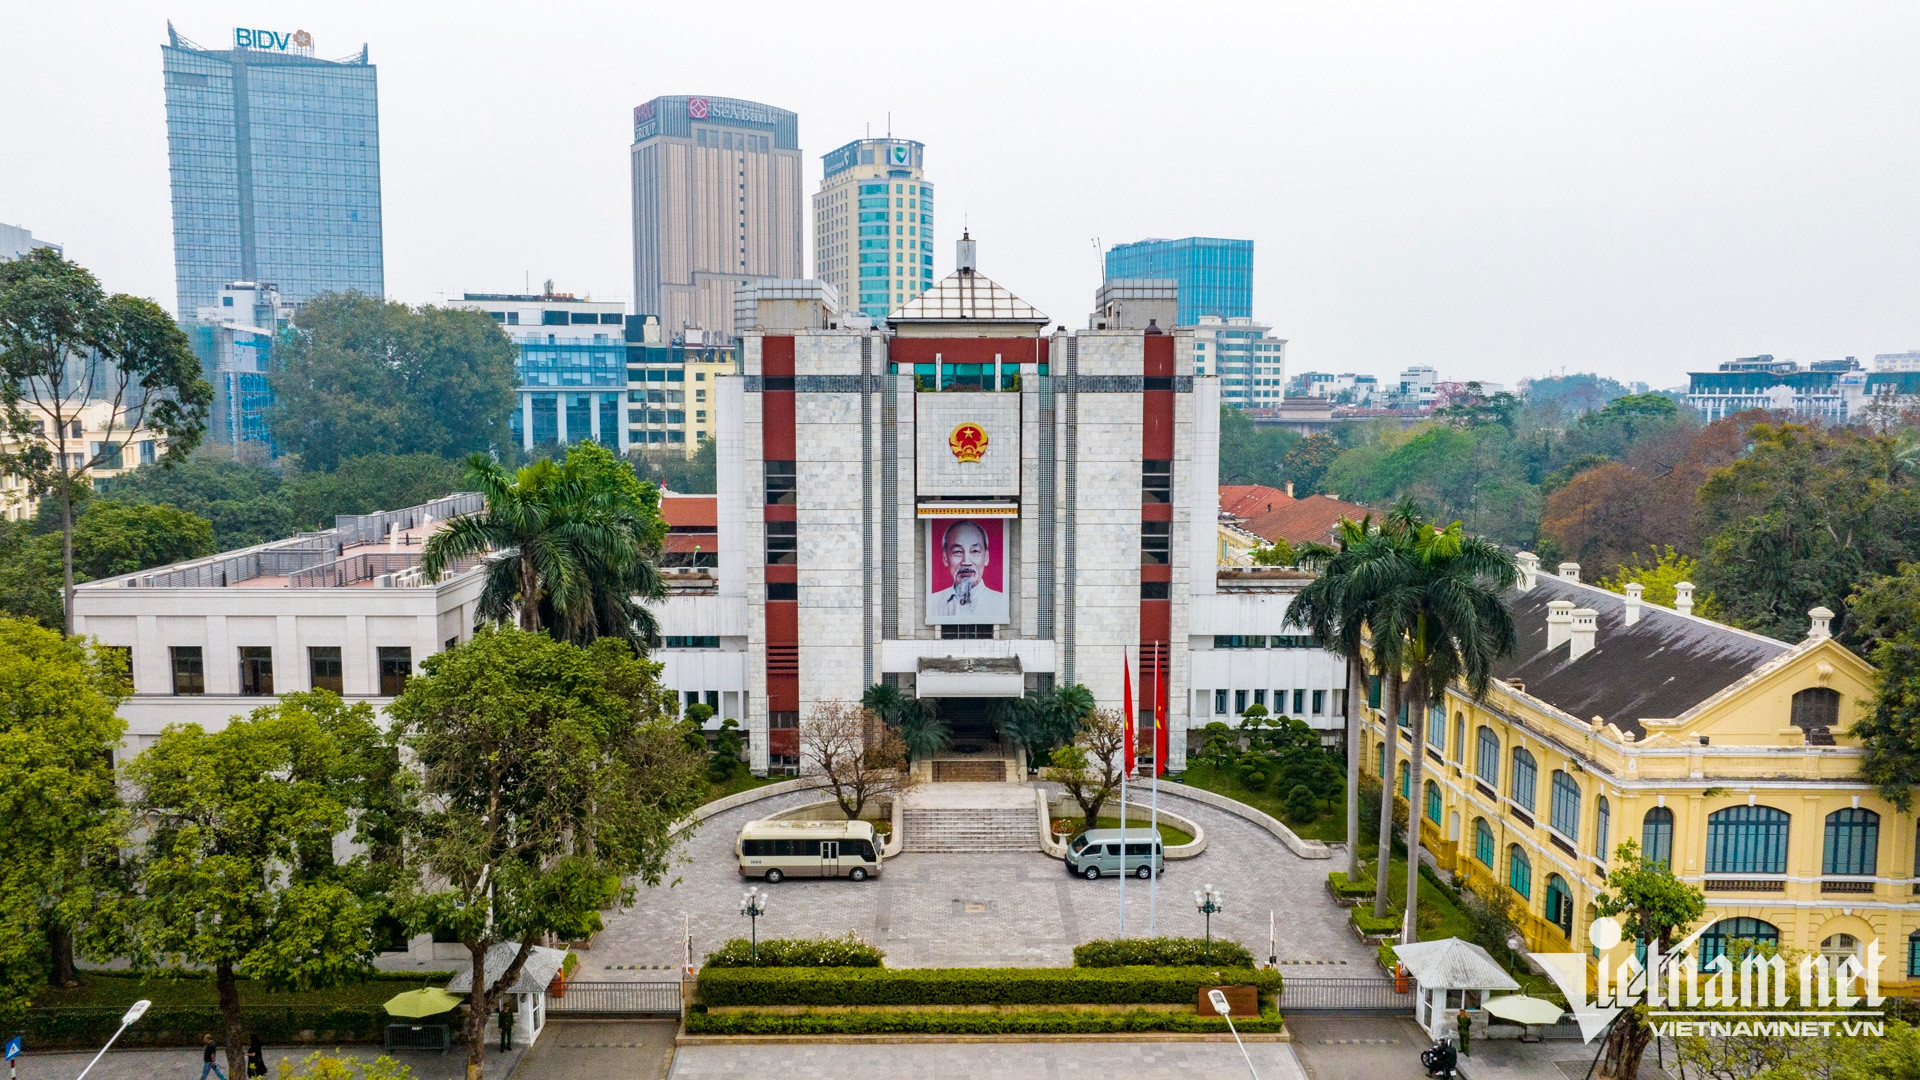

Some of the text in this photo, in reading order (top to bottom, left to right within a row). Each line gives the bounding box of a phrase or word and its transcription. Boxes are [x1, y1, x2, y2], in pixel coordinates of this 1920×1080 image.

[236, 27, 291, 51] BIDV
[712, 104, 776, 124] SeABank
[634, 122, 656, 141] GROUP
